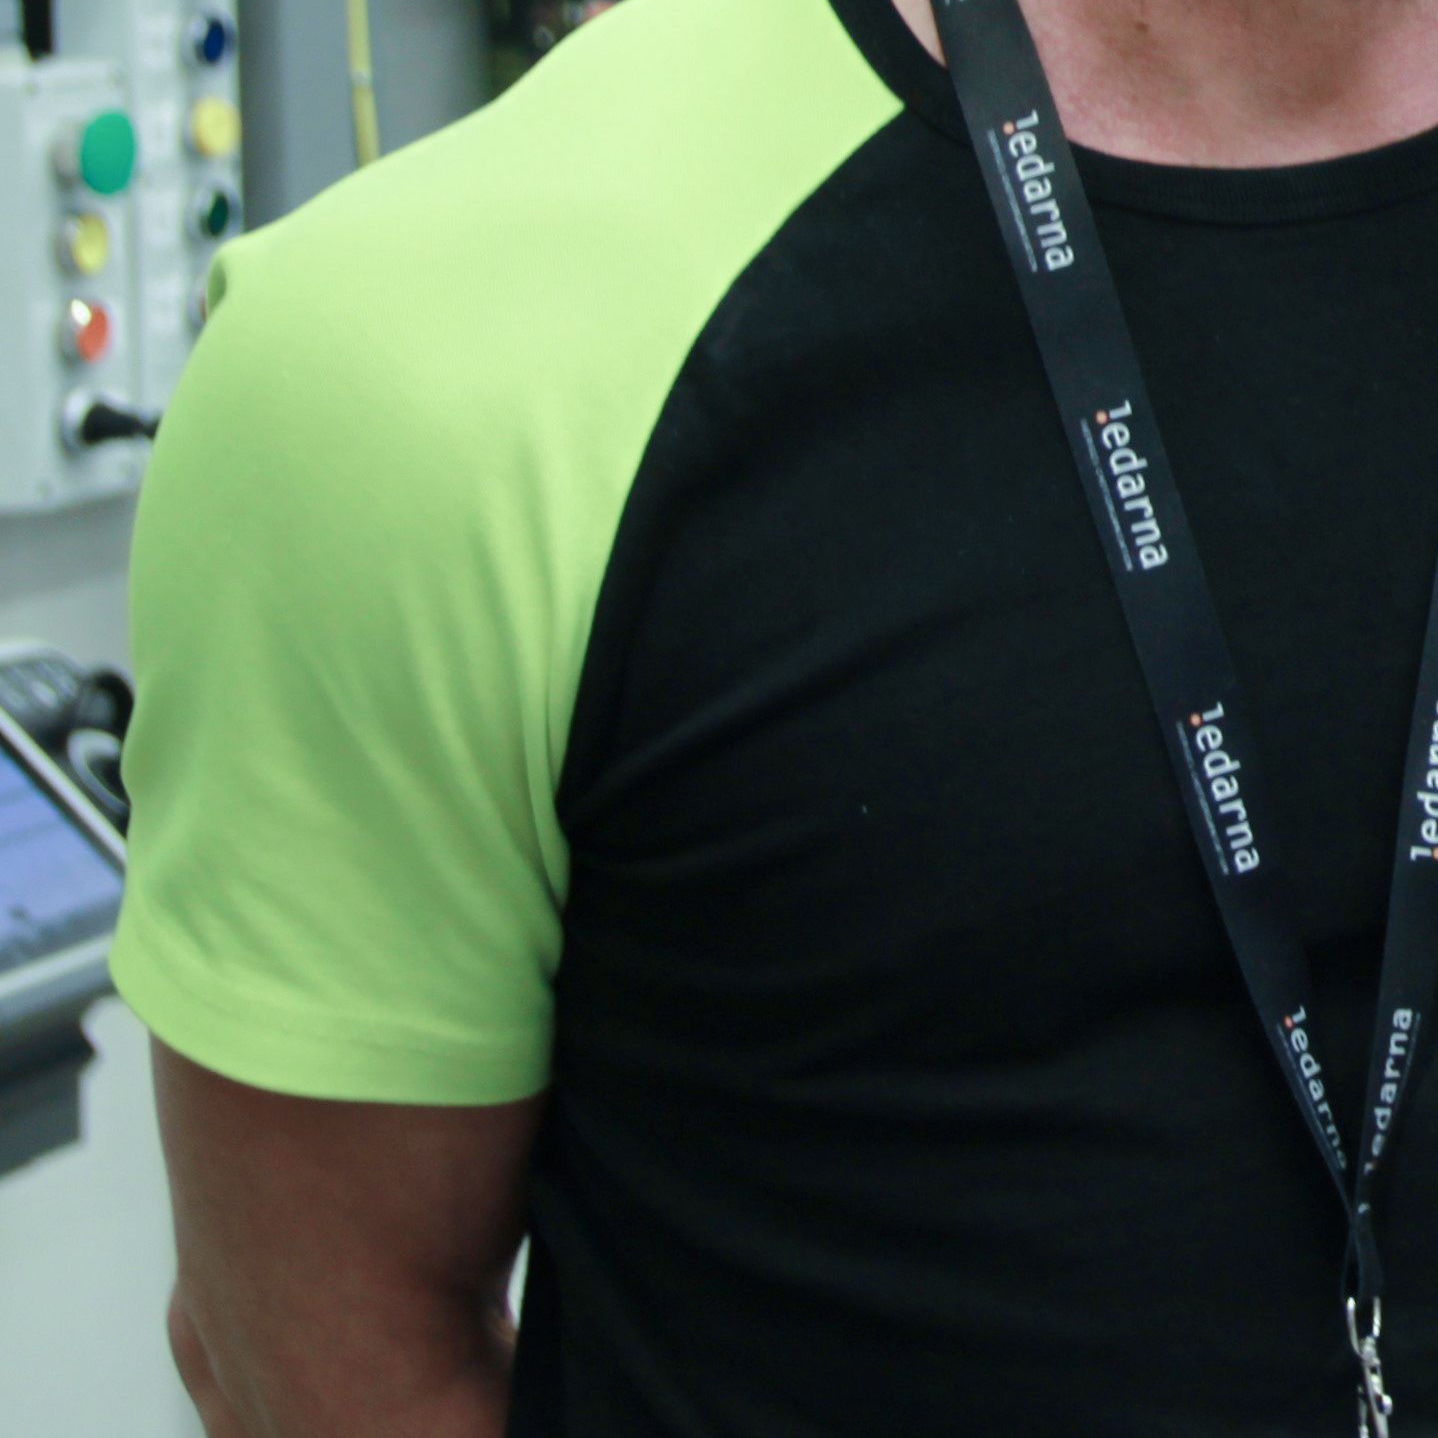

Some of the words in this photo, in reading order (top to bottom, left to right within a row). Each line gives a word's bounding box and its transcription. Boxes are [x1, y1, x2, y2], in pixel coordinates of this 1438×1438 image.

[1003, 109, 1075, 271] ledarna
[1096, 399, 1169, 570] ledarna
[1190, 702, 1260, 873] ledarna
